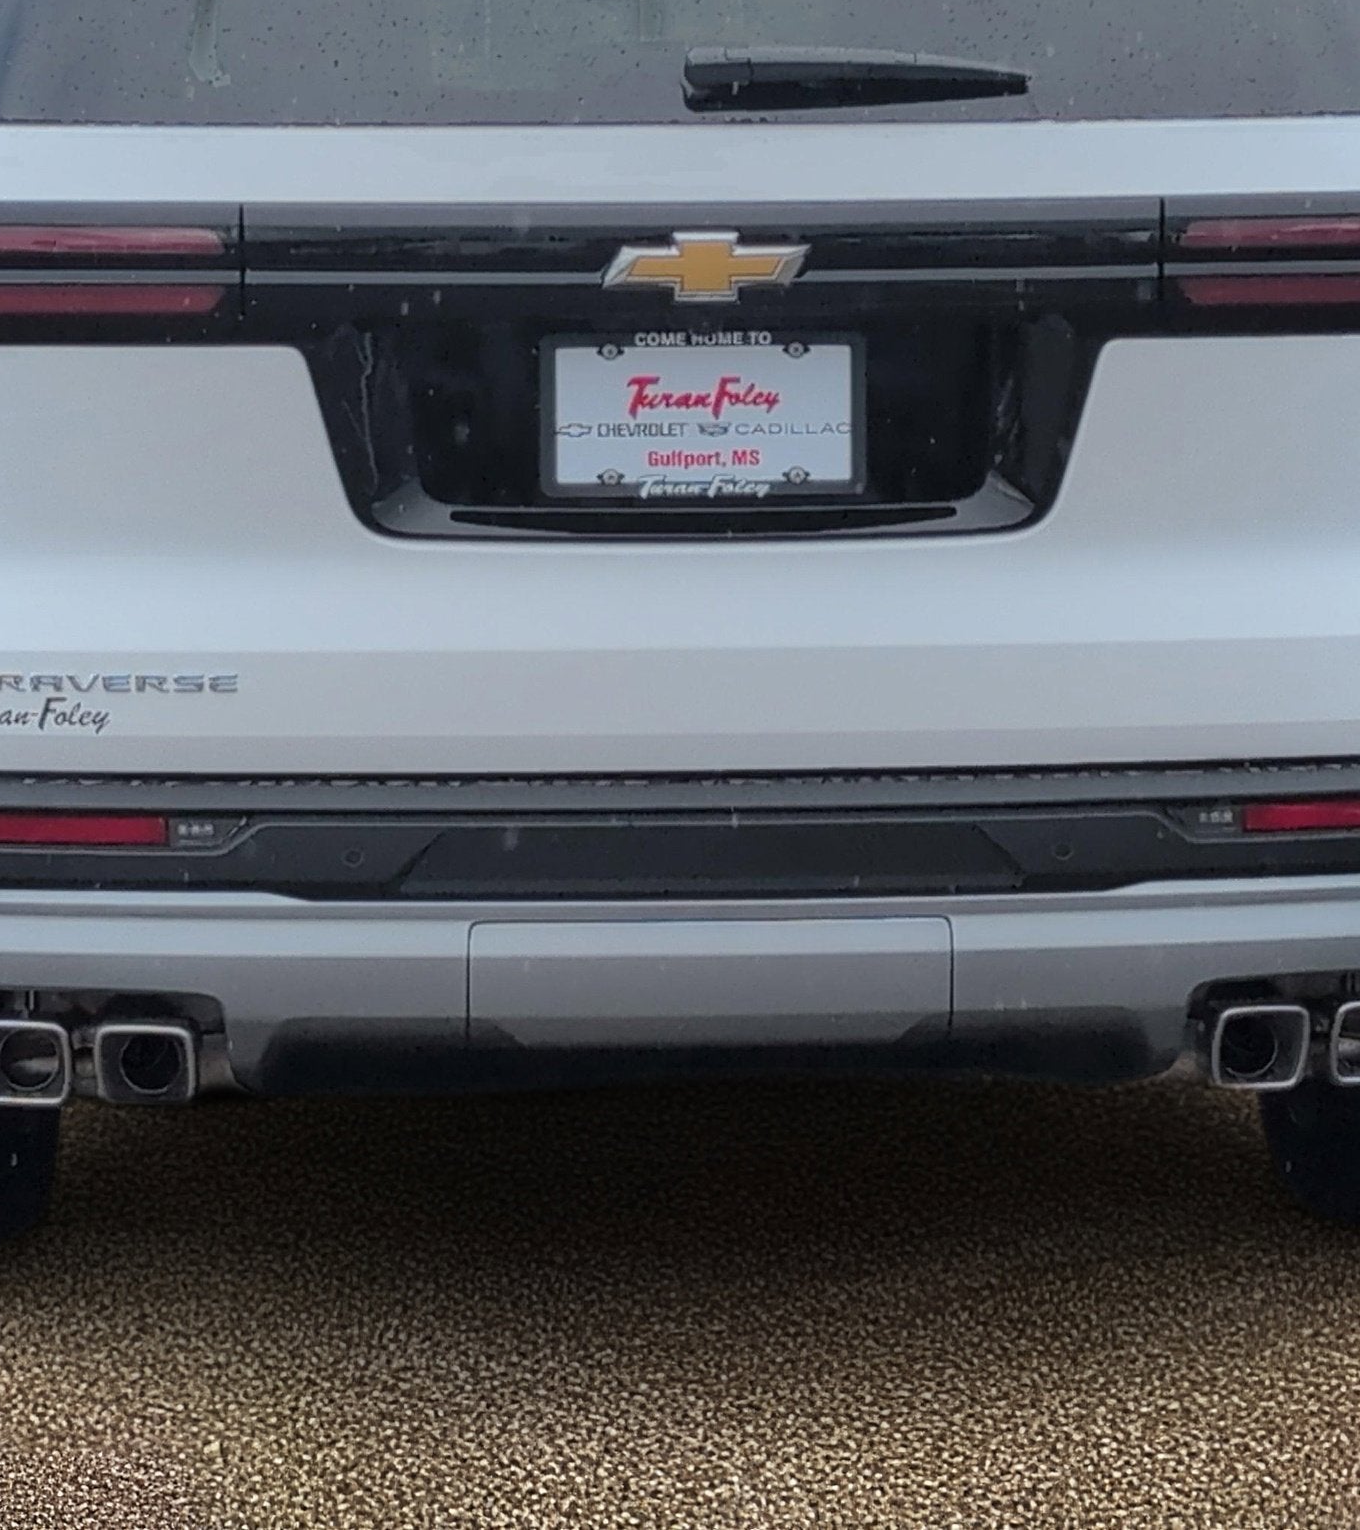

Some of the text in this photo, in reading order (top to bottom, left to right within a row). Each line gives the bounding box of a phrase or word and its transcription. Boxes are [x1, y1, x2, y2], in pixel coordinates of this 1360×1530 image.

[634, 331, 773, 346] COME HOME TO
[597, 421, 852, 438] CHEVROLET CADILLAC
[648, 449, 761, 469] Gulfport, MS
